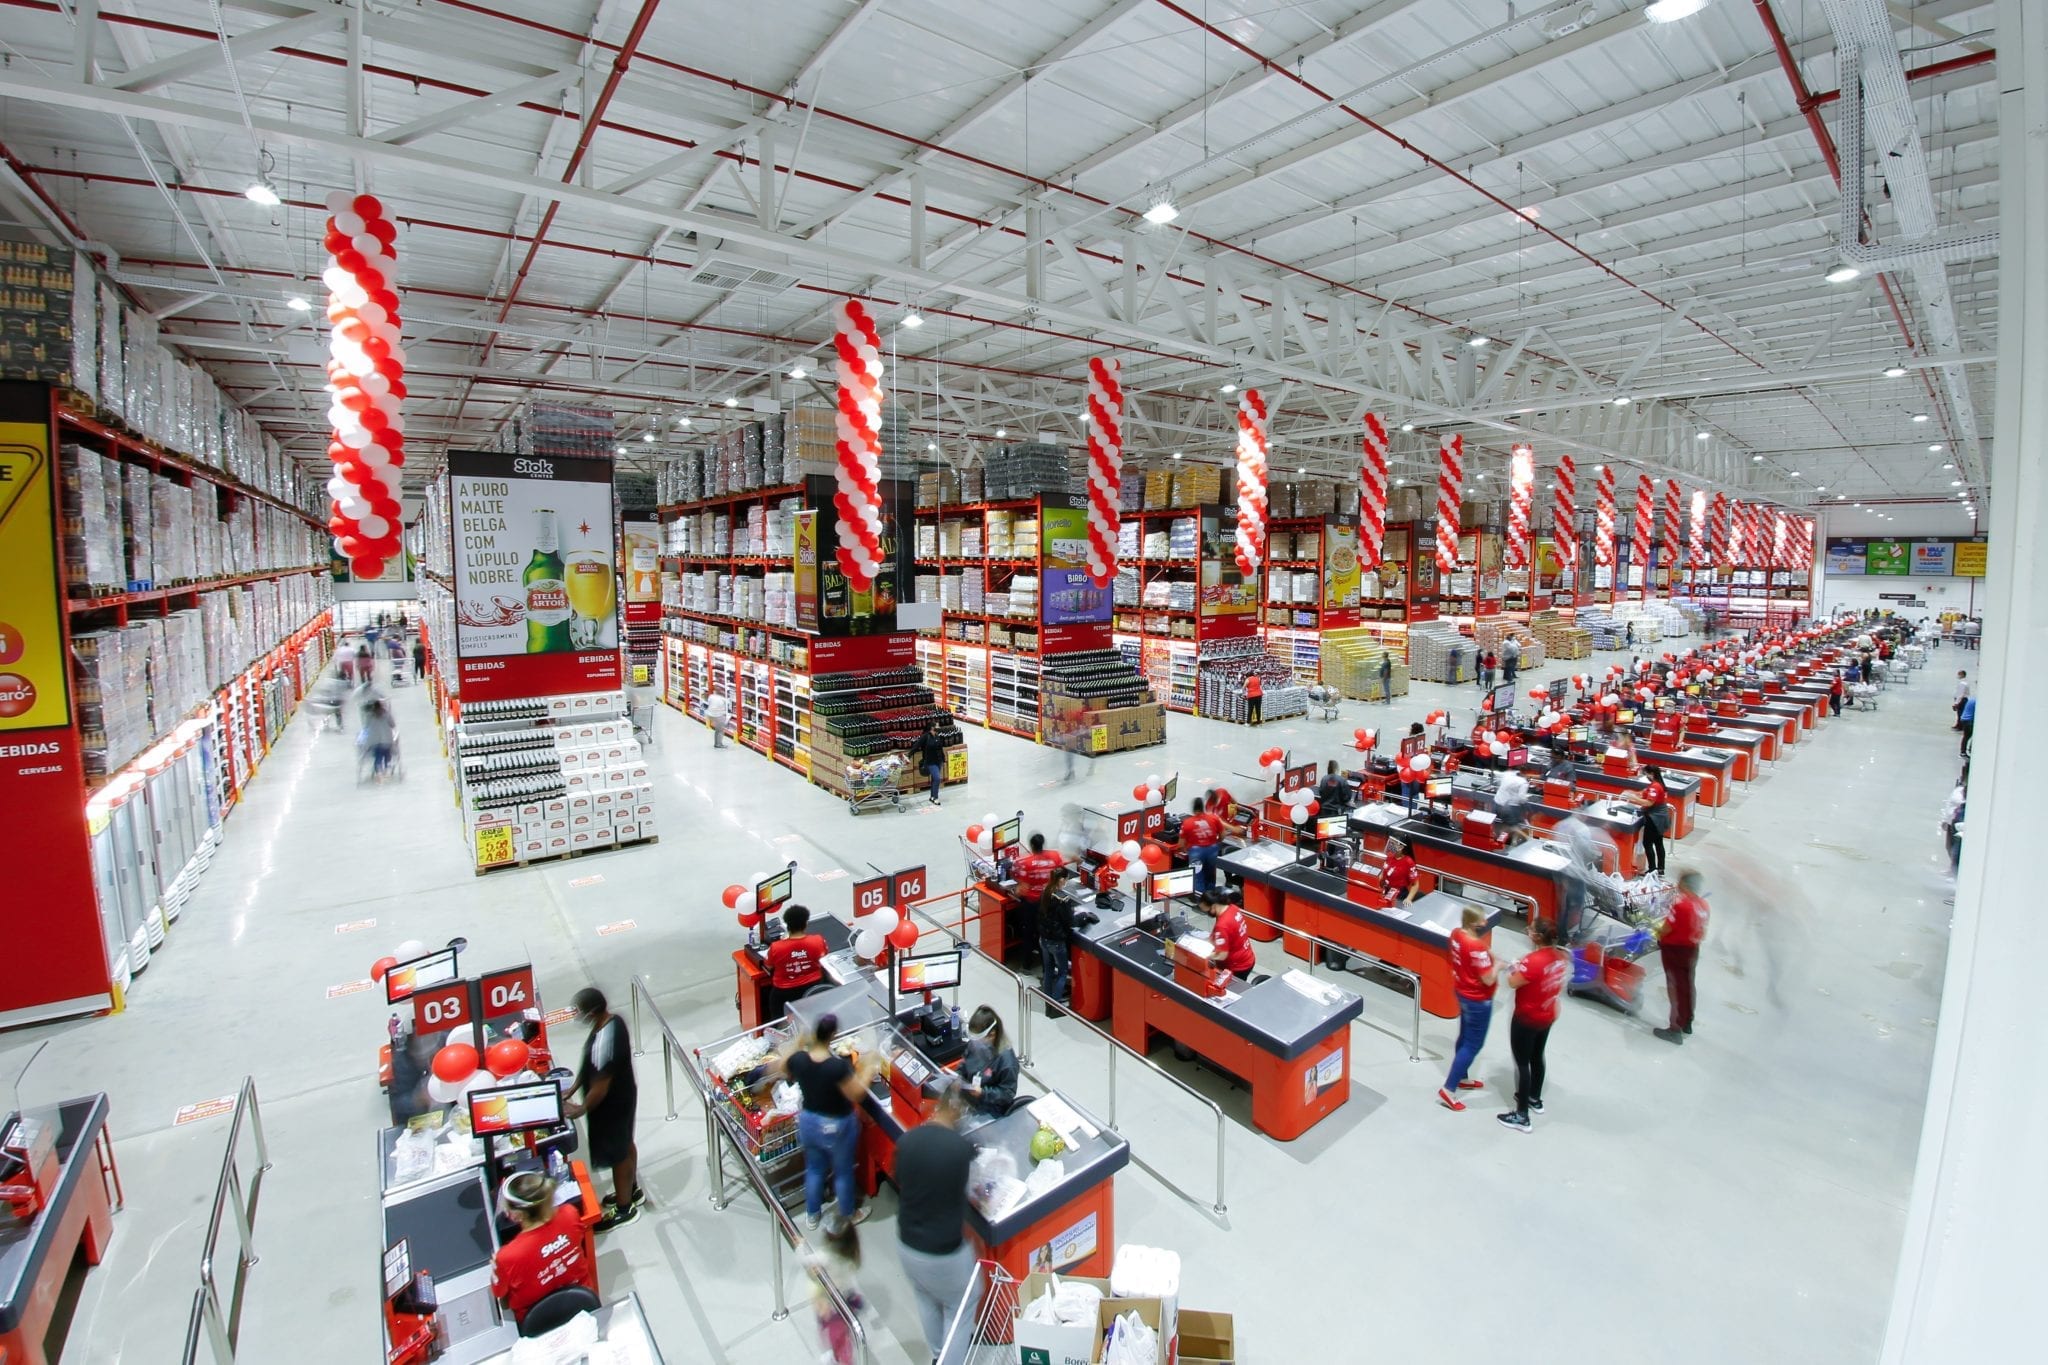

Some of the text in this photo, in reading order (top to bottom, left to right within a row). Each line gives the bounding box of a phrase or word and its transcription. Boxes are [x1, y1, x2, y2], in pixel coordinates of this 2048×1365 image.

[514, 458, 554, 475] Stok
[460, 482, 508, 497] A PURO
[461, 500, 504, 514] MALTE
[463, 518, 507, 532] BELGA
[465, 536, 495, 550] COM
[467, 551, 519, 568] LÚPULO
[469, 570, 519, 585] NOBRE.
[532, 592, 565, 601] STELLA
[532, 599, 566, 608] ARTOIS
[814, 641, 841, 649] BEBIDAS
[464, 662, 505, 672] BEBIDAS
[578, 655, 615, 664] BEBIDAS
[0, 742, 60, 758] EBIDAS
[1406, 739, 1424, 754] 11 12
[18, 765, 63, 776] CERVEJAS
[1289, 770, 1315, 788] 09 10
[1123, 813, 1161, 835] 07 08
[861, 878, 921, 909] 05 06
[424, 981, 526, 1024] 03 04
[541, 1234, 570, 1258] Stok
